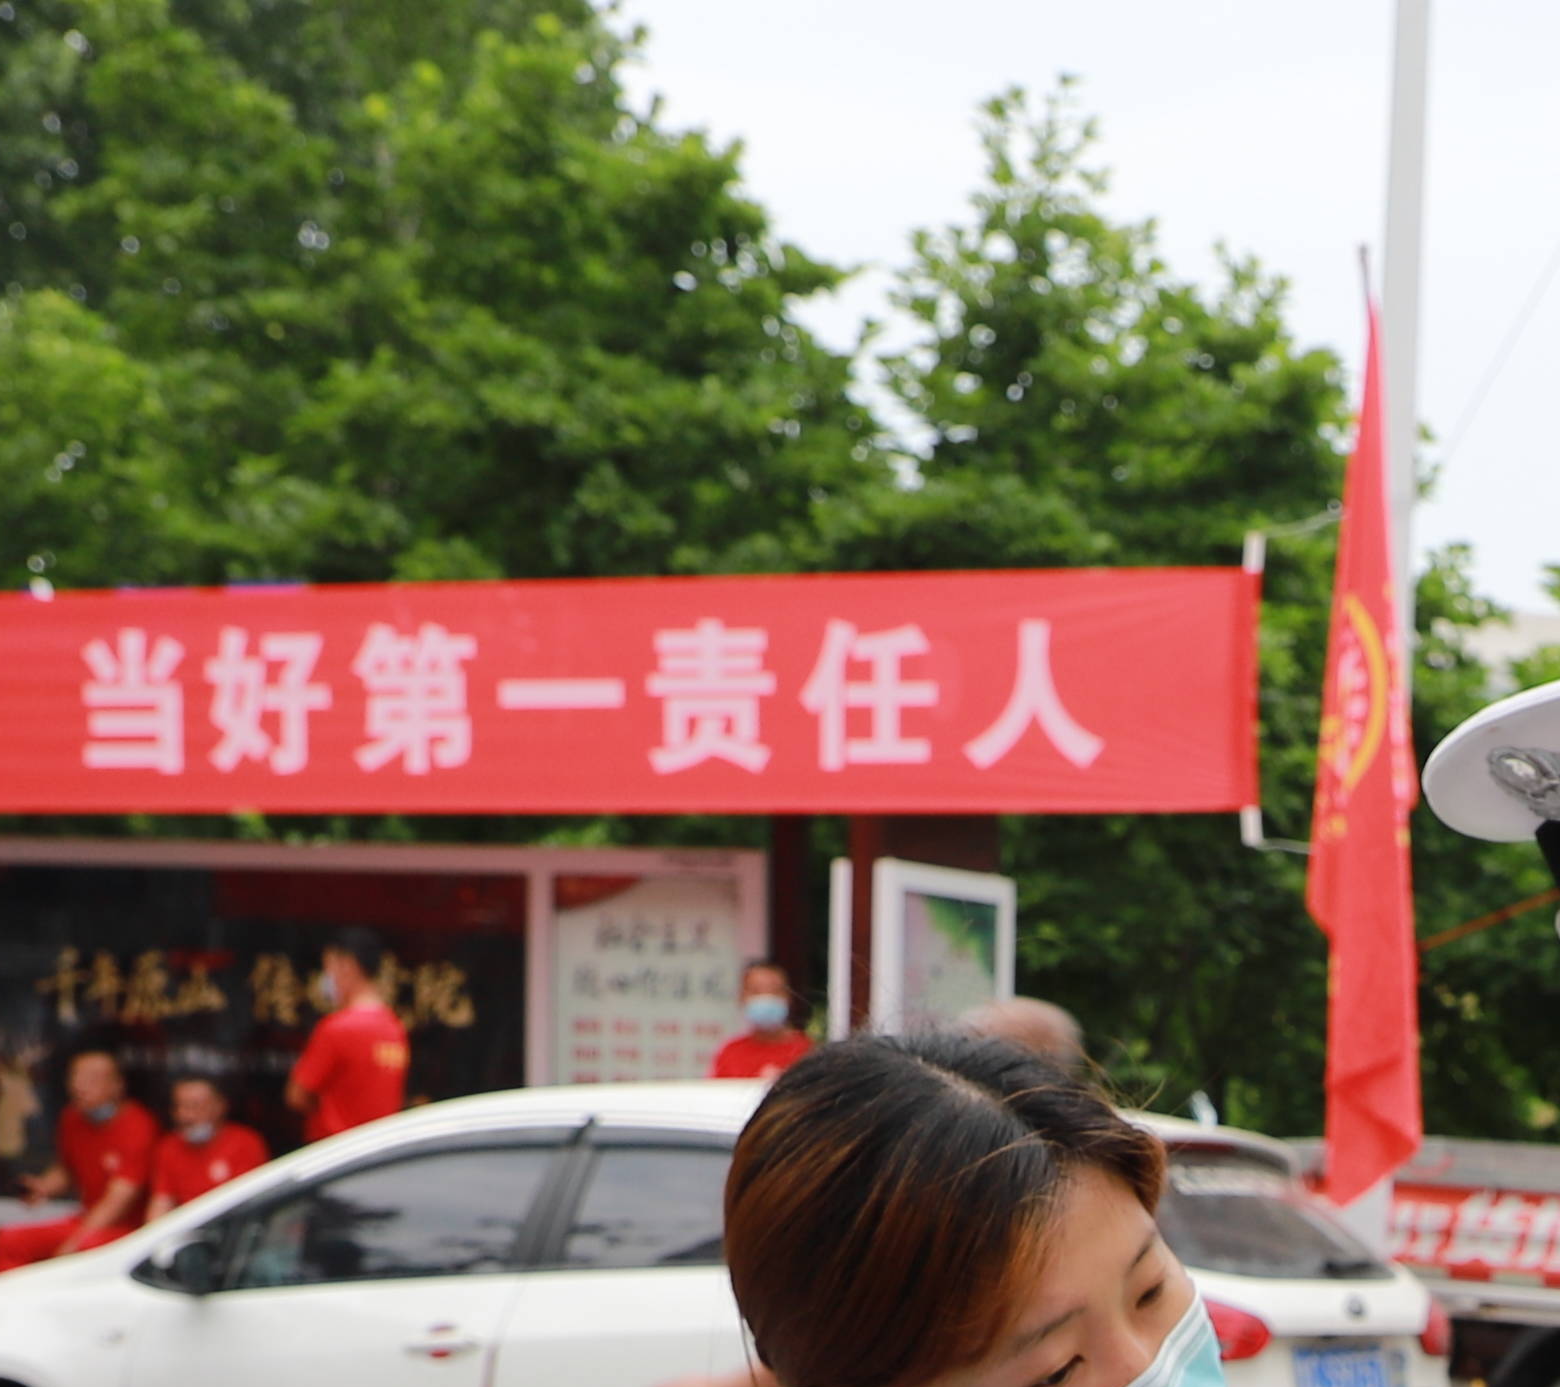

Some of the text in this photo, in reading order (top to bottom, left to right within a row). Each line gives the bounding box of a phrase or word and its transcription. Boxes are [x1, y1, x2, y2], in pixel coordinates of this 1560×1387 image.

[80, 616, 1104, 778] 当好第一责任人
